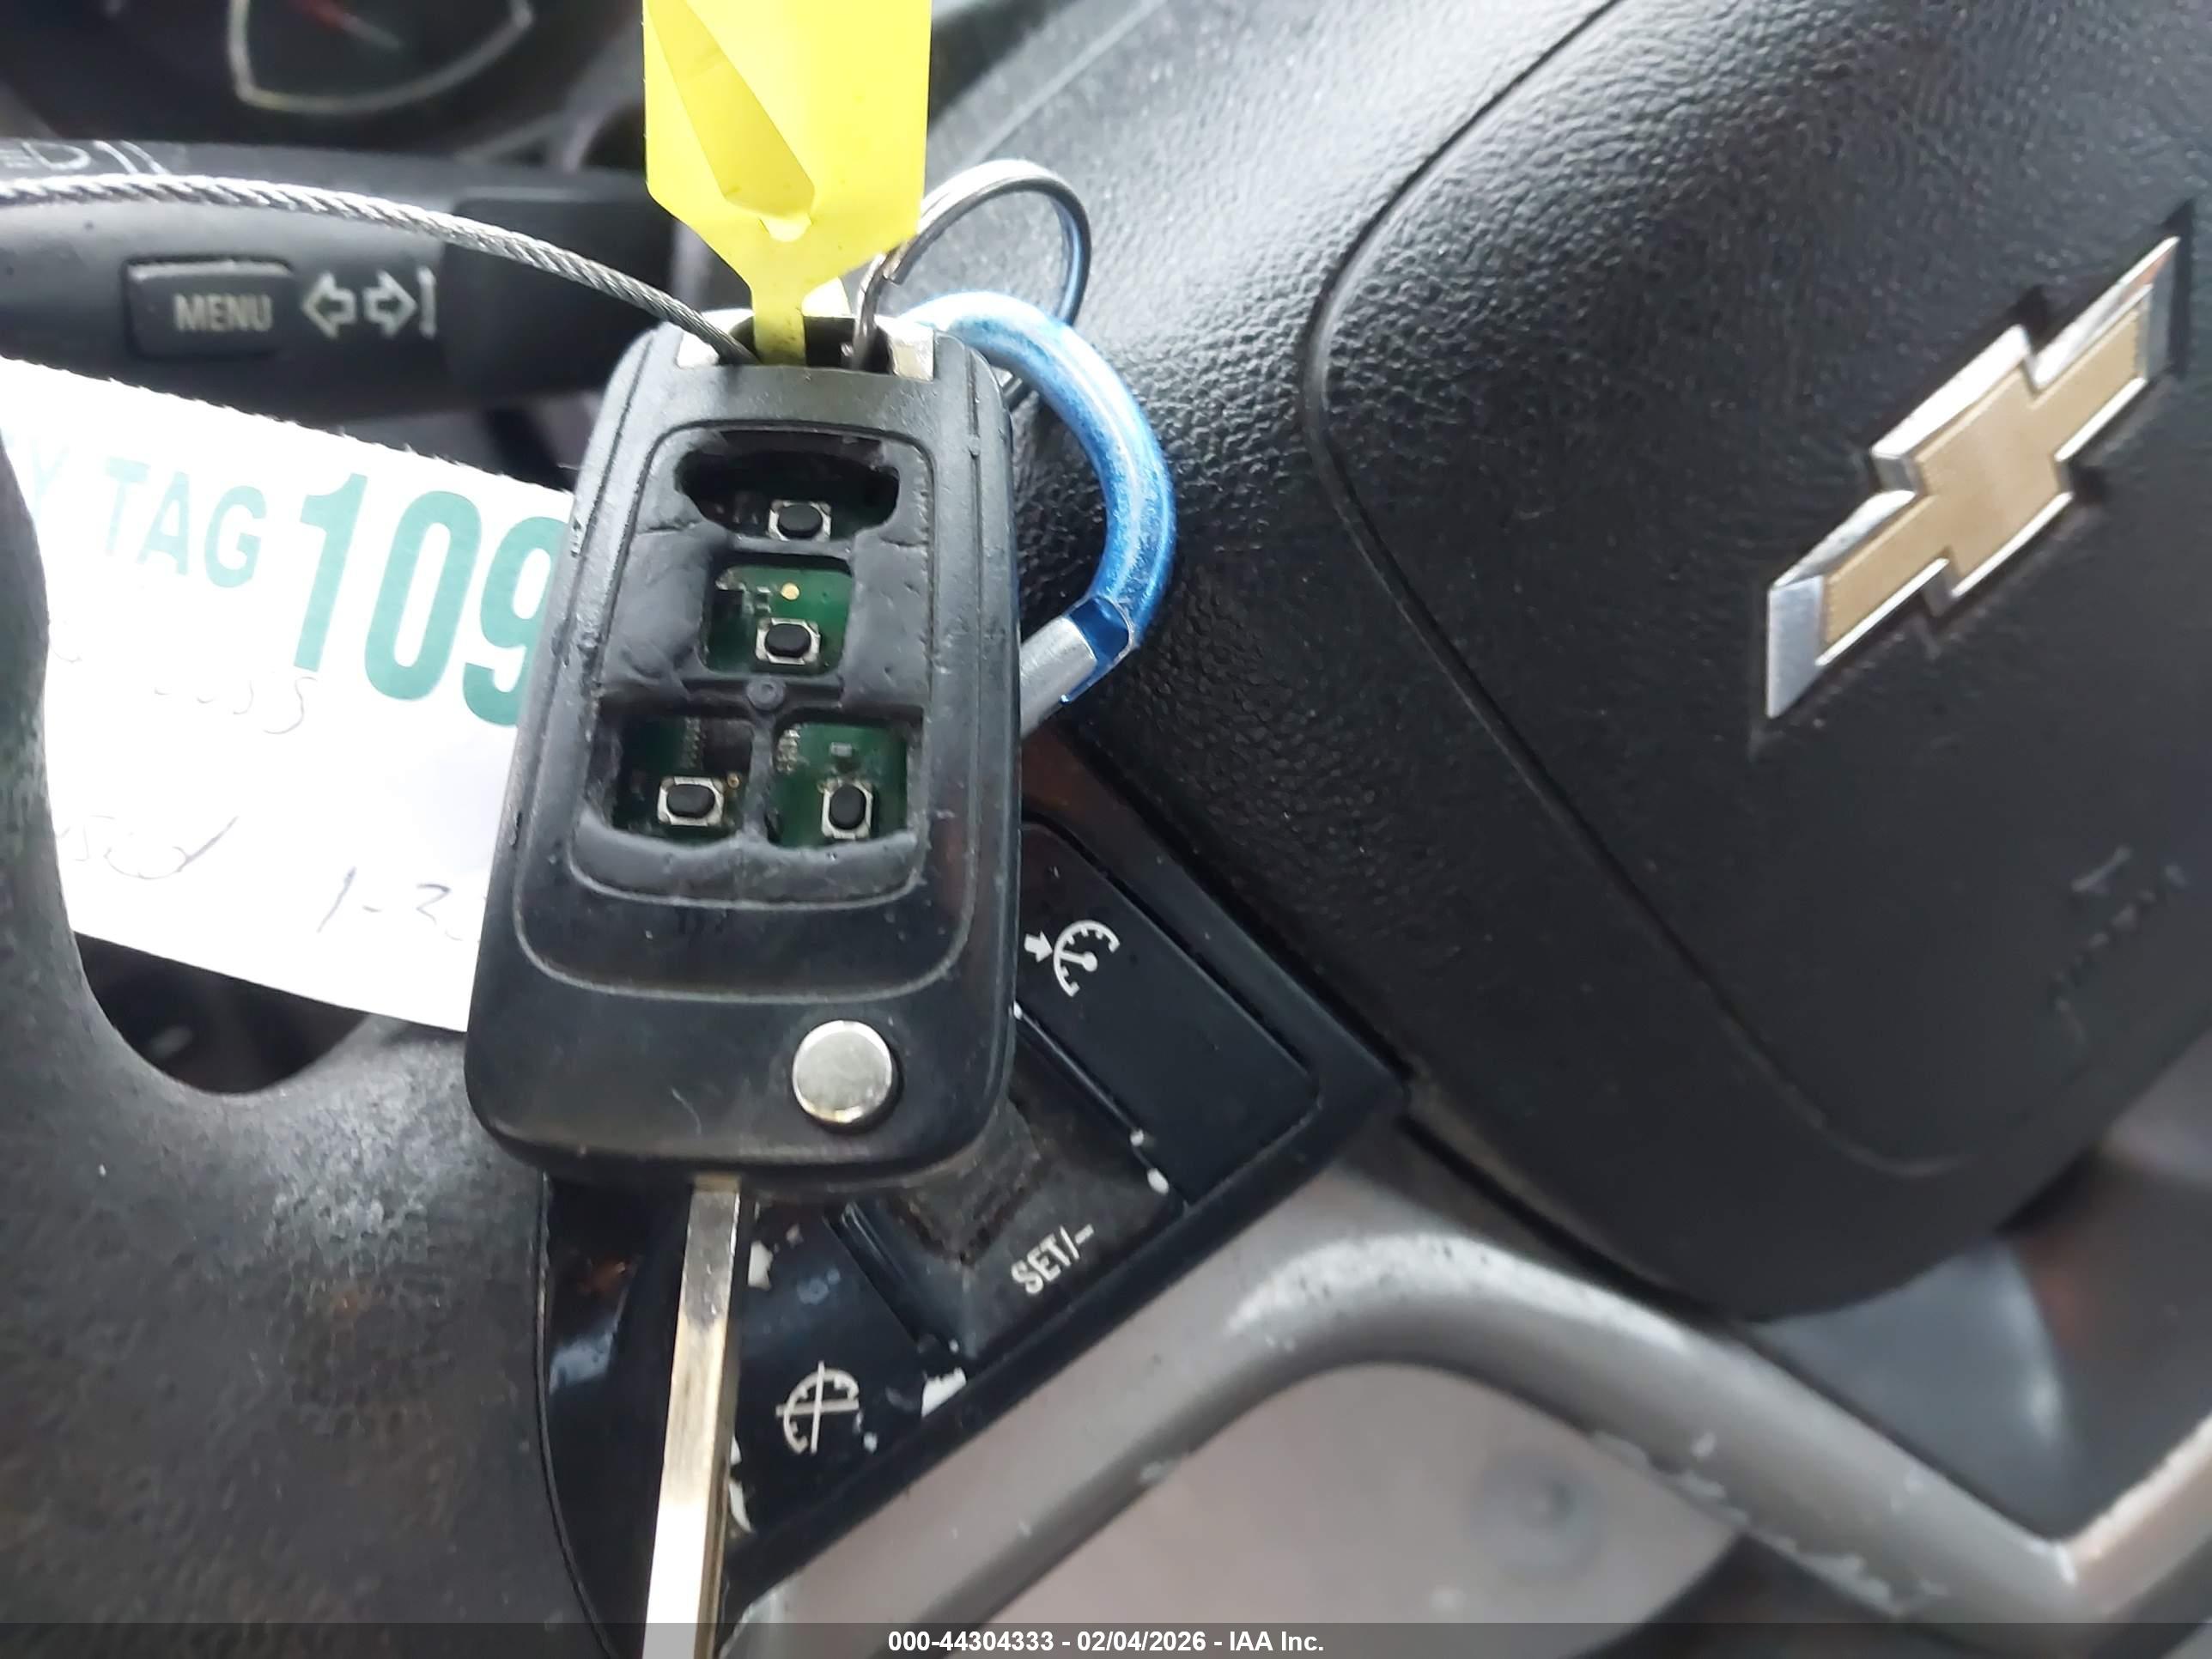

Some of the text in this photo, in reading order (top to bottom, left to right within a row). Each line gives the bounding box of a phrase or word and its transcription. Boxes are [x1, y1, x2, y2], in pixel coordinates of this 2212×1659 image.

[173, 293, 273, 332] MENU
[104, 455, 268, 587] TAG
[293, 472, 572, 726] 109
[1011, 1224, 1095, 1294] SET/-
